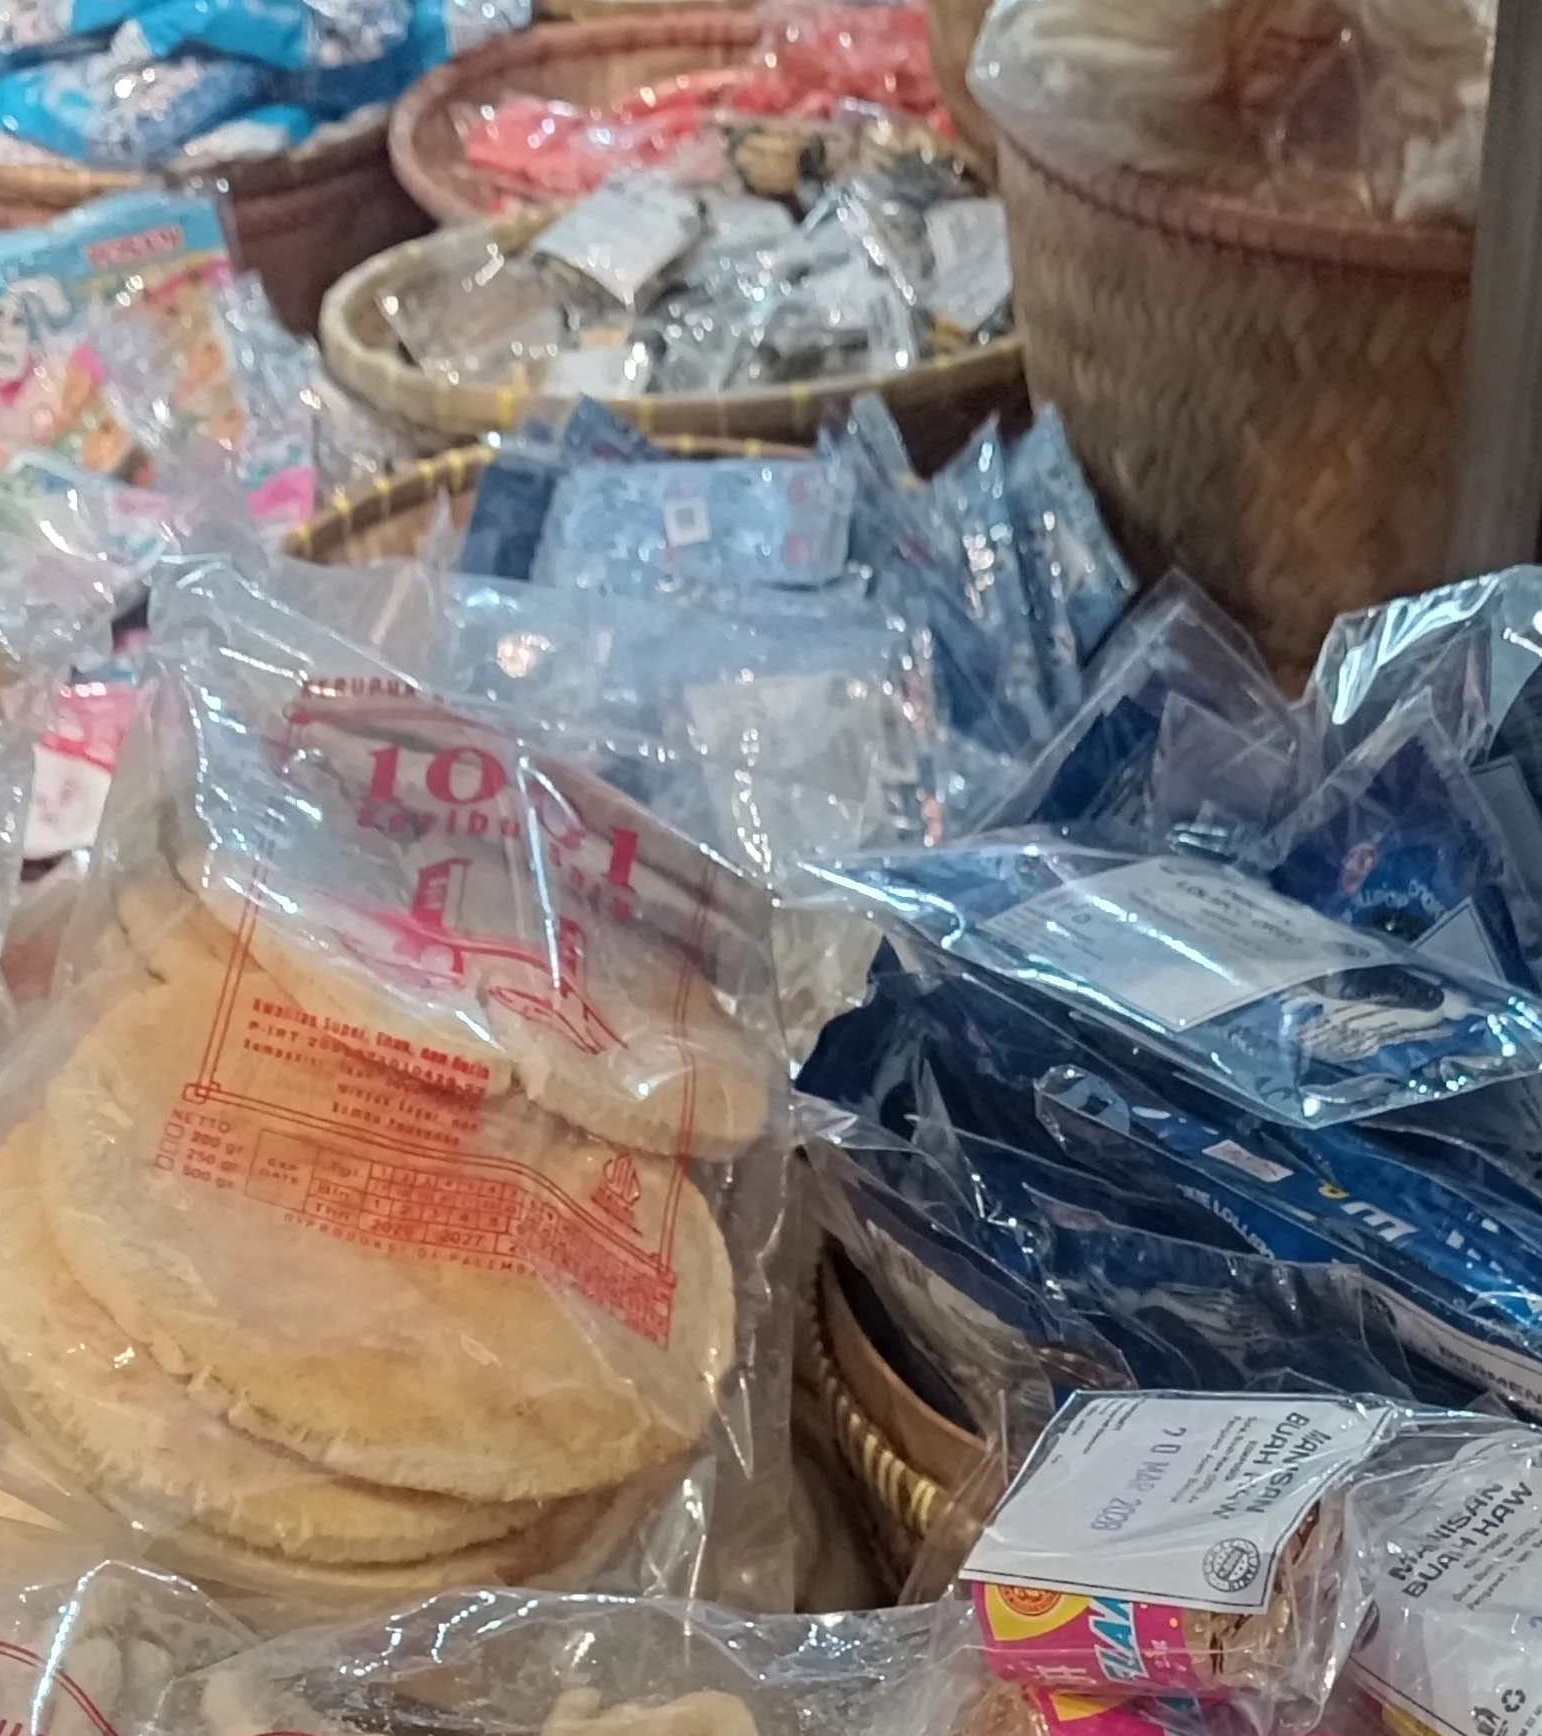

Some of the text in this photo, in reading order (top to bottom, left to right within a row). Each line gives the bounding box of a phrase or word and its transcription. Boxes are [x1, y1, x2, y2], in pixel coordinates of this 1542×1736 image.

[170, 1108, 232, 1135] NETTO
[439, 1226, 484, 1251] 2027
[1250, 1409, 1309, 1470] BUAH
[1387, 1474, 1505, 1586] MANISAN
[1401, 1479, 1534, 1603] BUAH HAW
